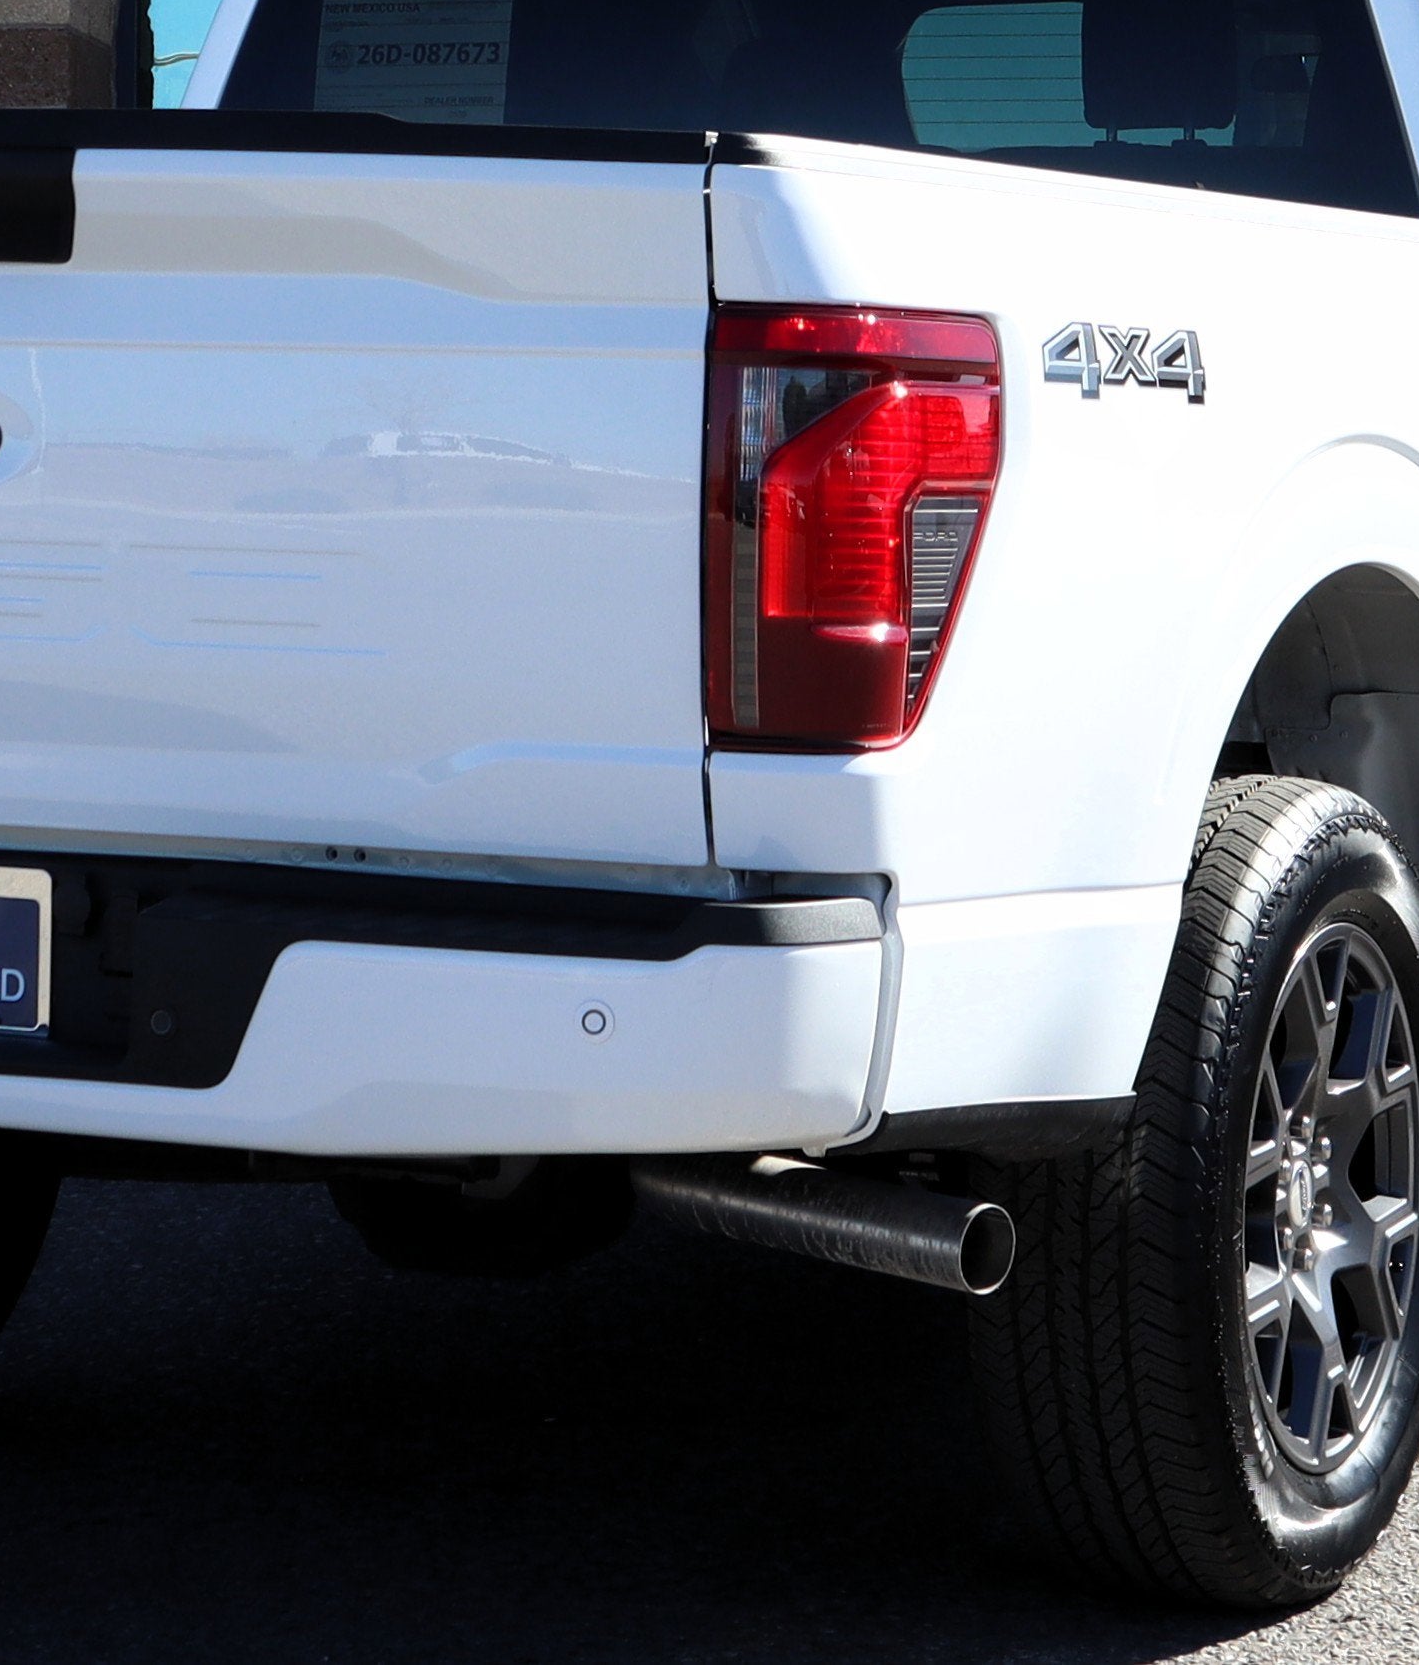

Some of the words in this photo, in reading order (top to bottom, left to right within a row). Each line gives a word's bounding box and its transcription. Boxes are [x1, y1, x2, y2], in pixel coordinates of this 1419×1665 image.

[325, 3, 351, 14] NEW
[352, 3, 394, 14] MEXICO
[397, 2, 421, 13] USA
[357, 42, 501, 65] 26D-087673
